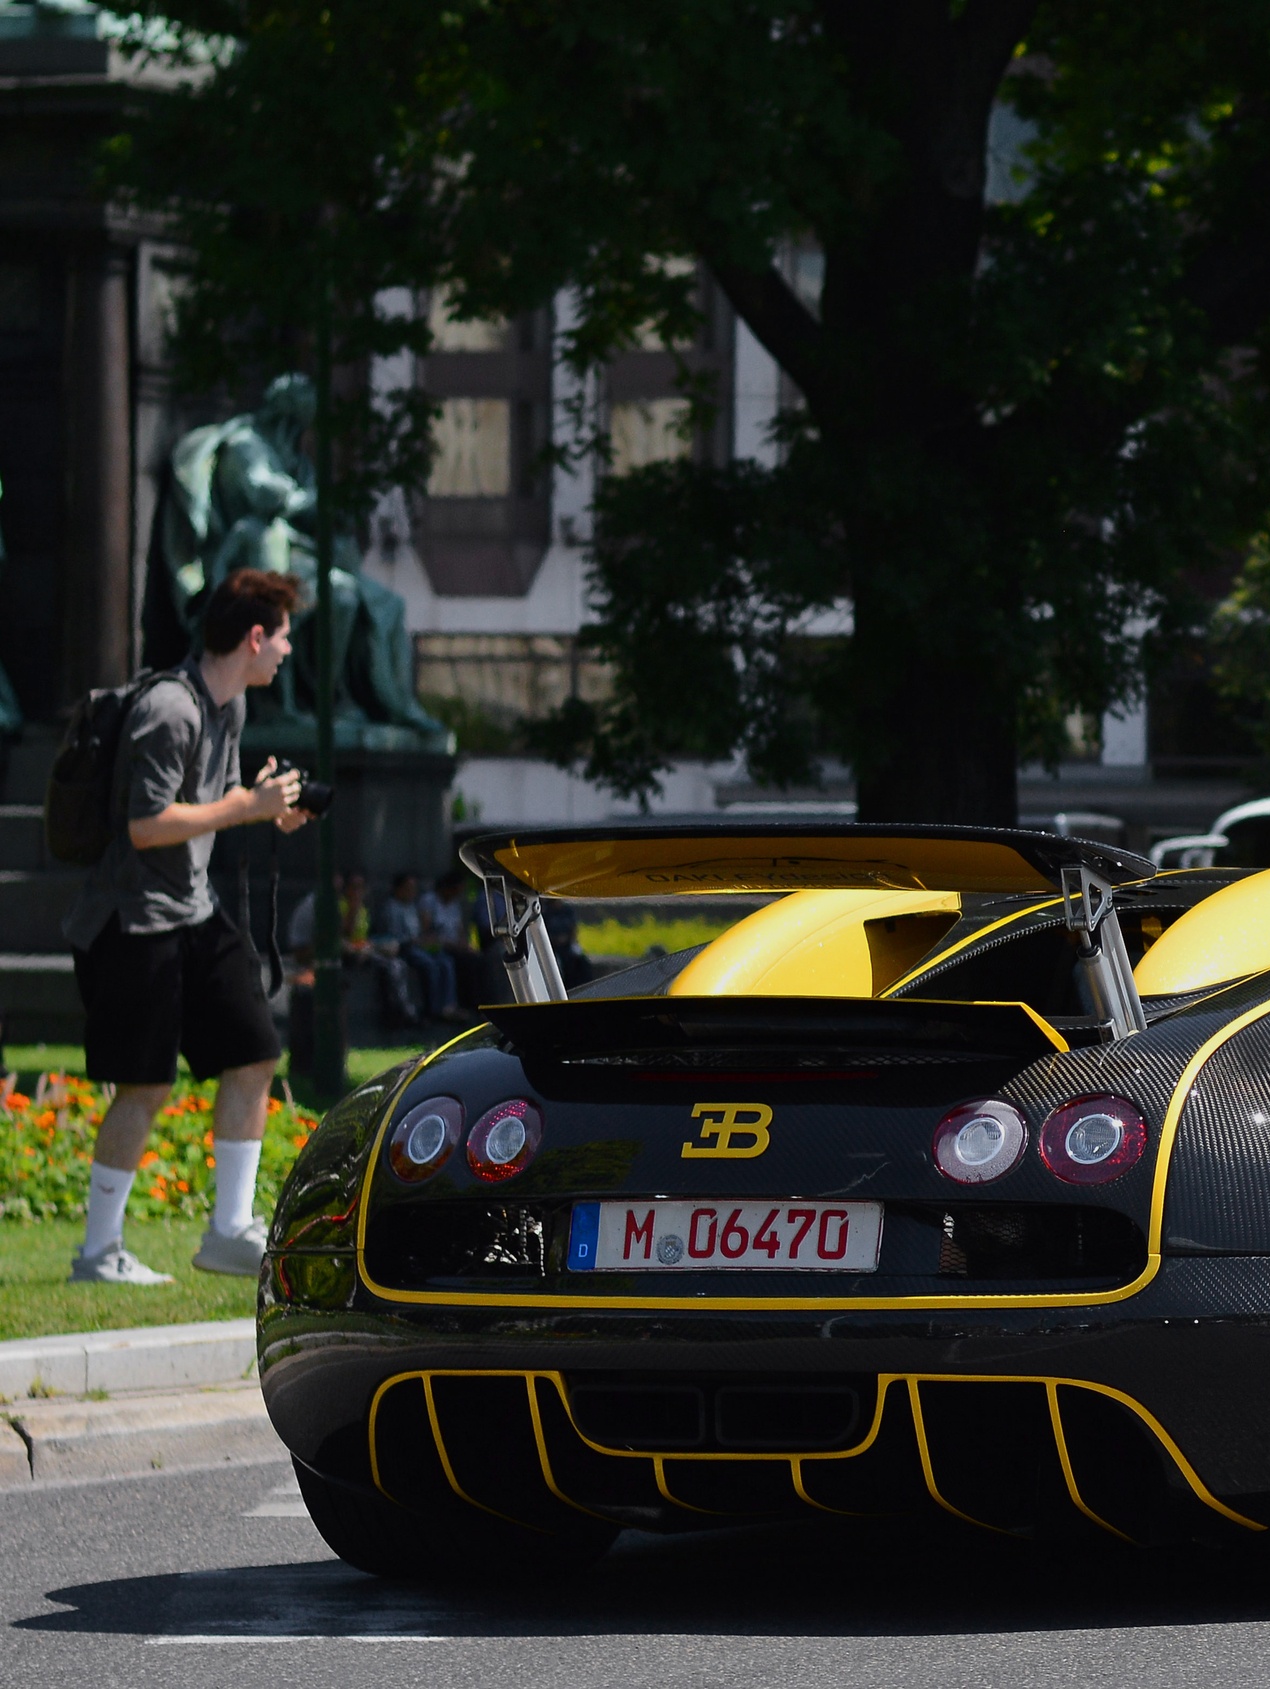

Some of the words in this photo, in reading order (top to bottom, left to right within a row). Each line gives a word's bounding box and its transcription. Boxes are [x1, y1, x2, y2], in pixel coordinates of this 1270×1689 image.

[578, 1243, 588, 1258] D
[623, 1209, 655, 1260] M
[688, 1208, 849, 1260] 06470
